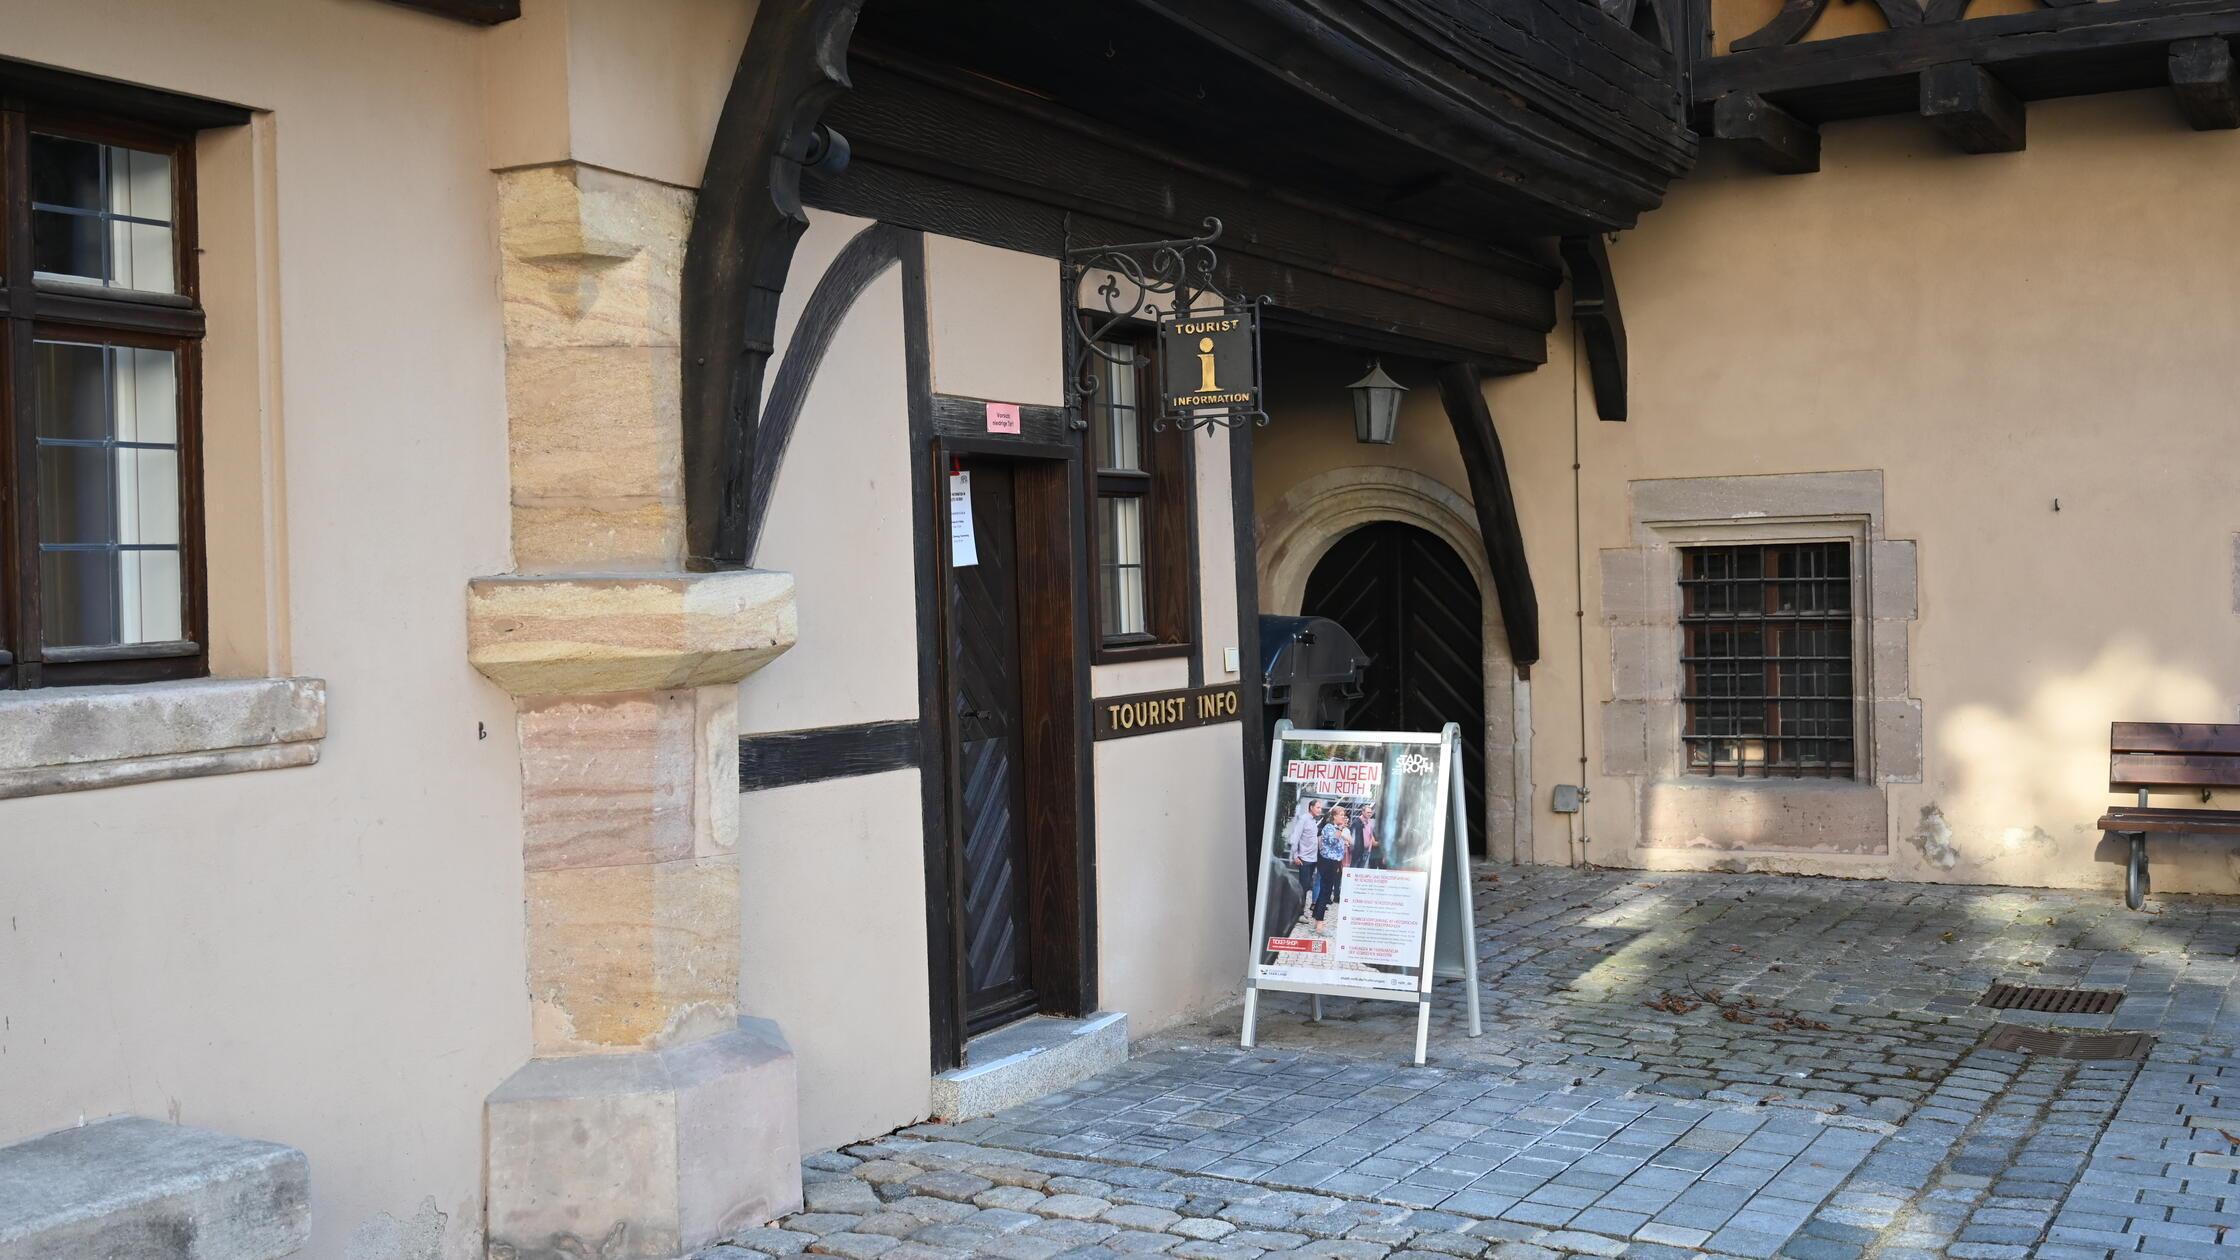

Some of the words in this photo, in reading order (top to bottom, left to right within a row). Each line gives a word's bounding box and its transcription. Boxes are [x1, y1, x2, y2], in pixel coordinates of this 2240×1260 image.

[1175, 319, 1240, 335] TOURIST
[1173, 392, 1250, 407] INFORMATION
[1107, 697, 1186, 730] TOURIST
[1197, 690, 1237, 719] INFO
[1288, 761, 1379, 782] FÜHRUNGEN
[1318, 780, 1330, 793] IN
[1334, 781, 1365, 795] ROTH
